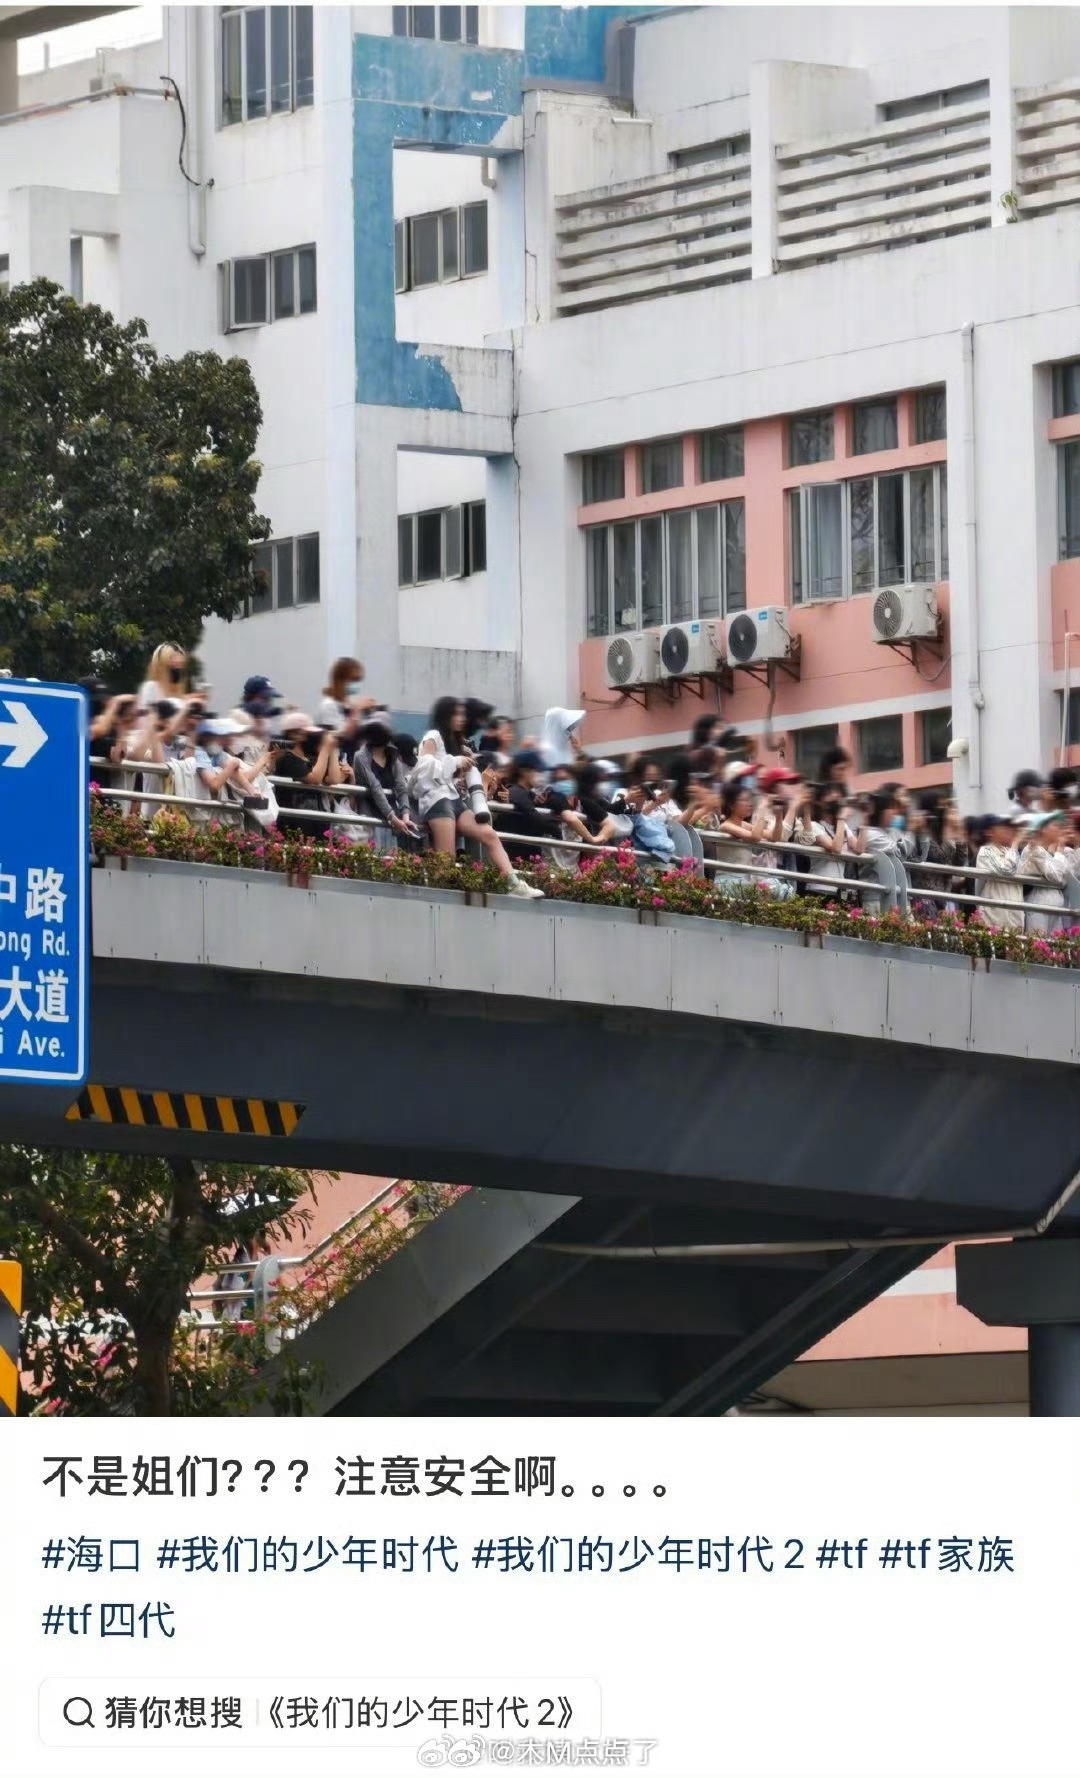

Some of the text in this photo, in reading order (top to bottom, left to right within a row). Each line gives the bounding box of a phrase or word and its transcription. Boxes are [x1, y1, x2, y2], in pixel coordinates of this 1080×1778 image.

[42, 929, 70, 956] Rd.
[0, 965, 70, 1023] 大道
[17, 1029, 65, 1058] Ave.
